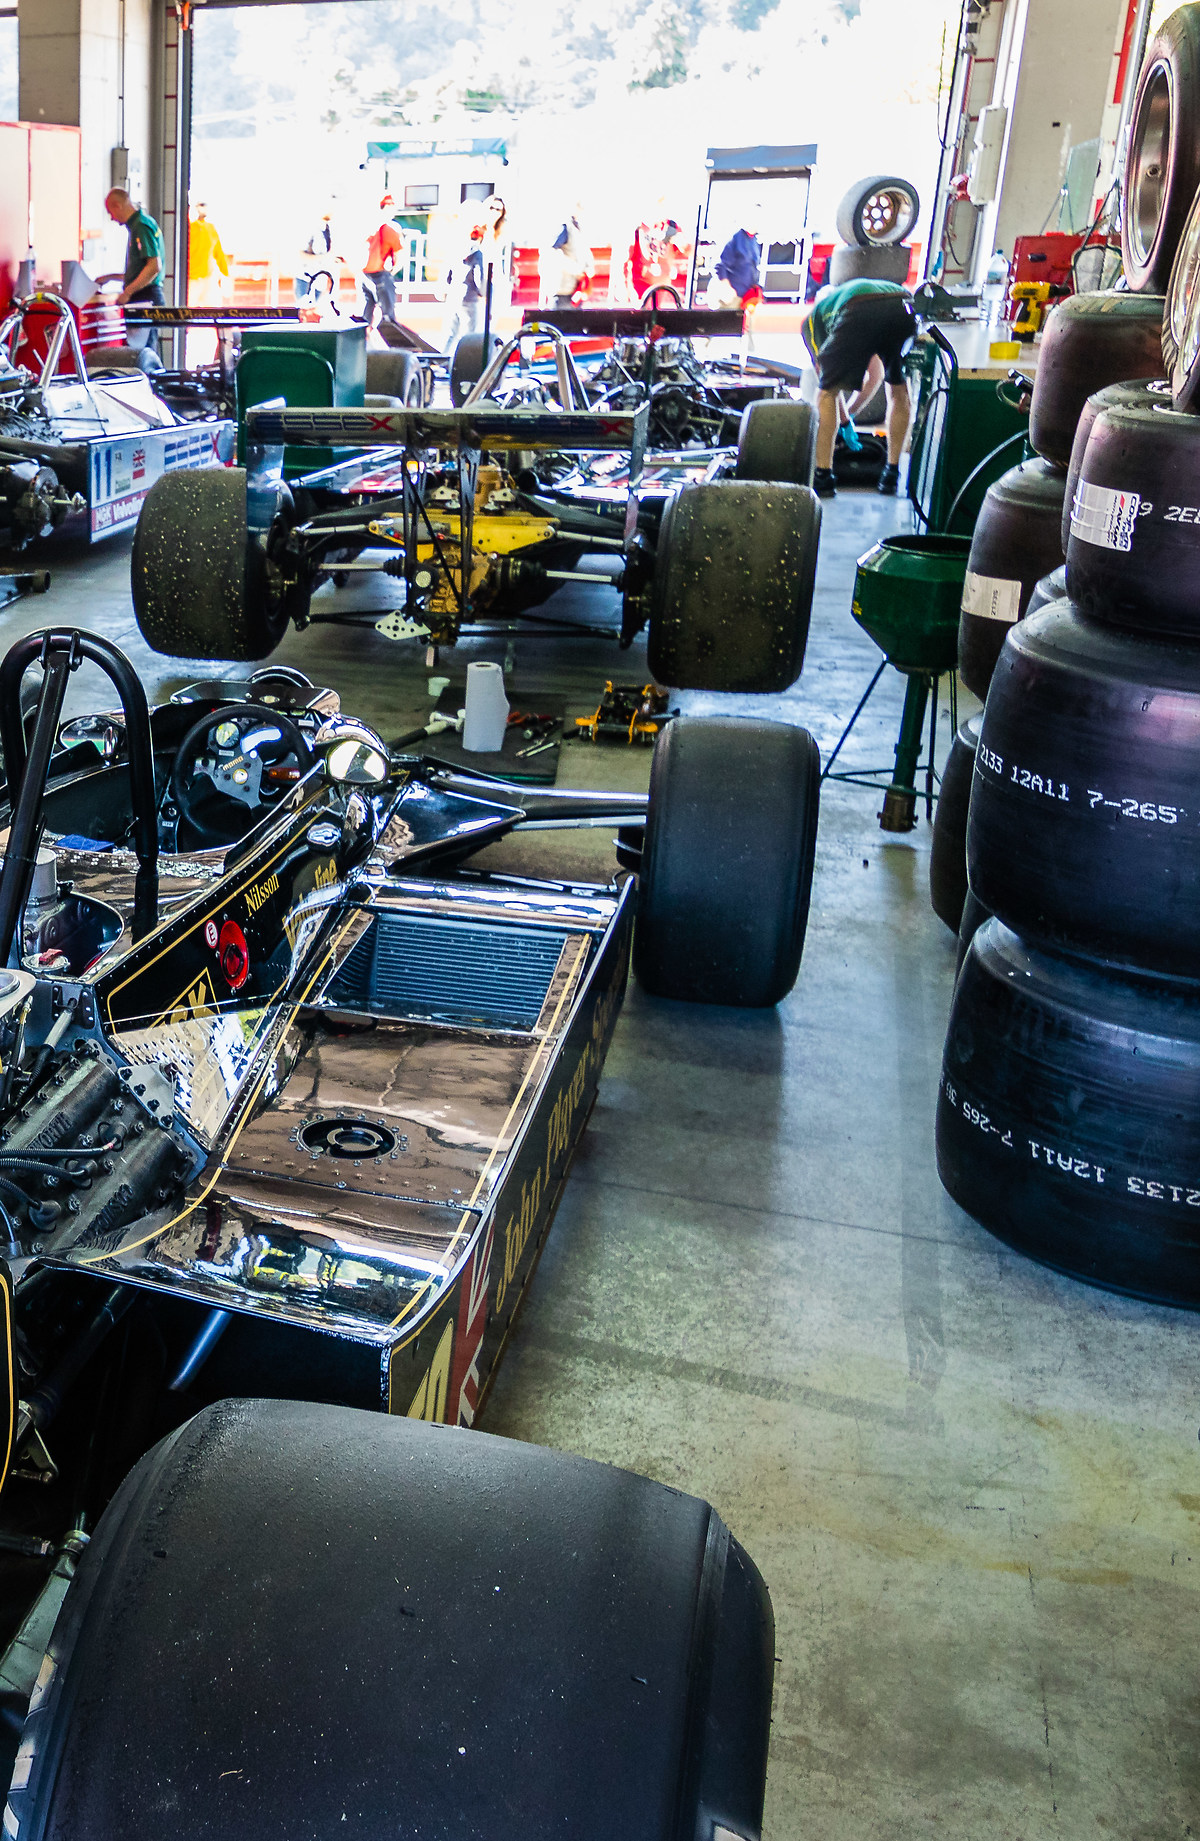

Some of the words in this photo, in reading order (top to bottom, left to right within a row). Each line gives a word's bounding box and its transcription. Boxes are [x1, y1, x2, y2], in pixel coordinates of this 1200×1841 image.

[980, 743, 1004, 774] 2133
[1010, 765, 1071, 802] 12A11
[1086, 789, 1178, 825] 7-265
[244, 872, 280, 918] Nilsson
[207, 927, 216, 944] E
[962, 1101, 1013, 1147] 7-265
[496, 1166, 542, 1315] John
[543, 1039, 591, 1190] Player
[1028, 1140, 1106, 1183] 12A11
[1127, 1176, 1200, 1206] 2133
